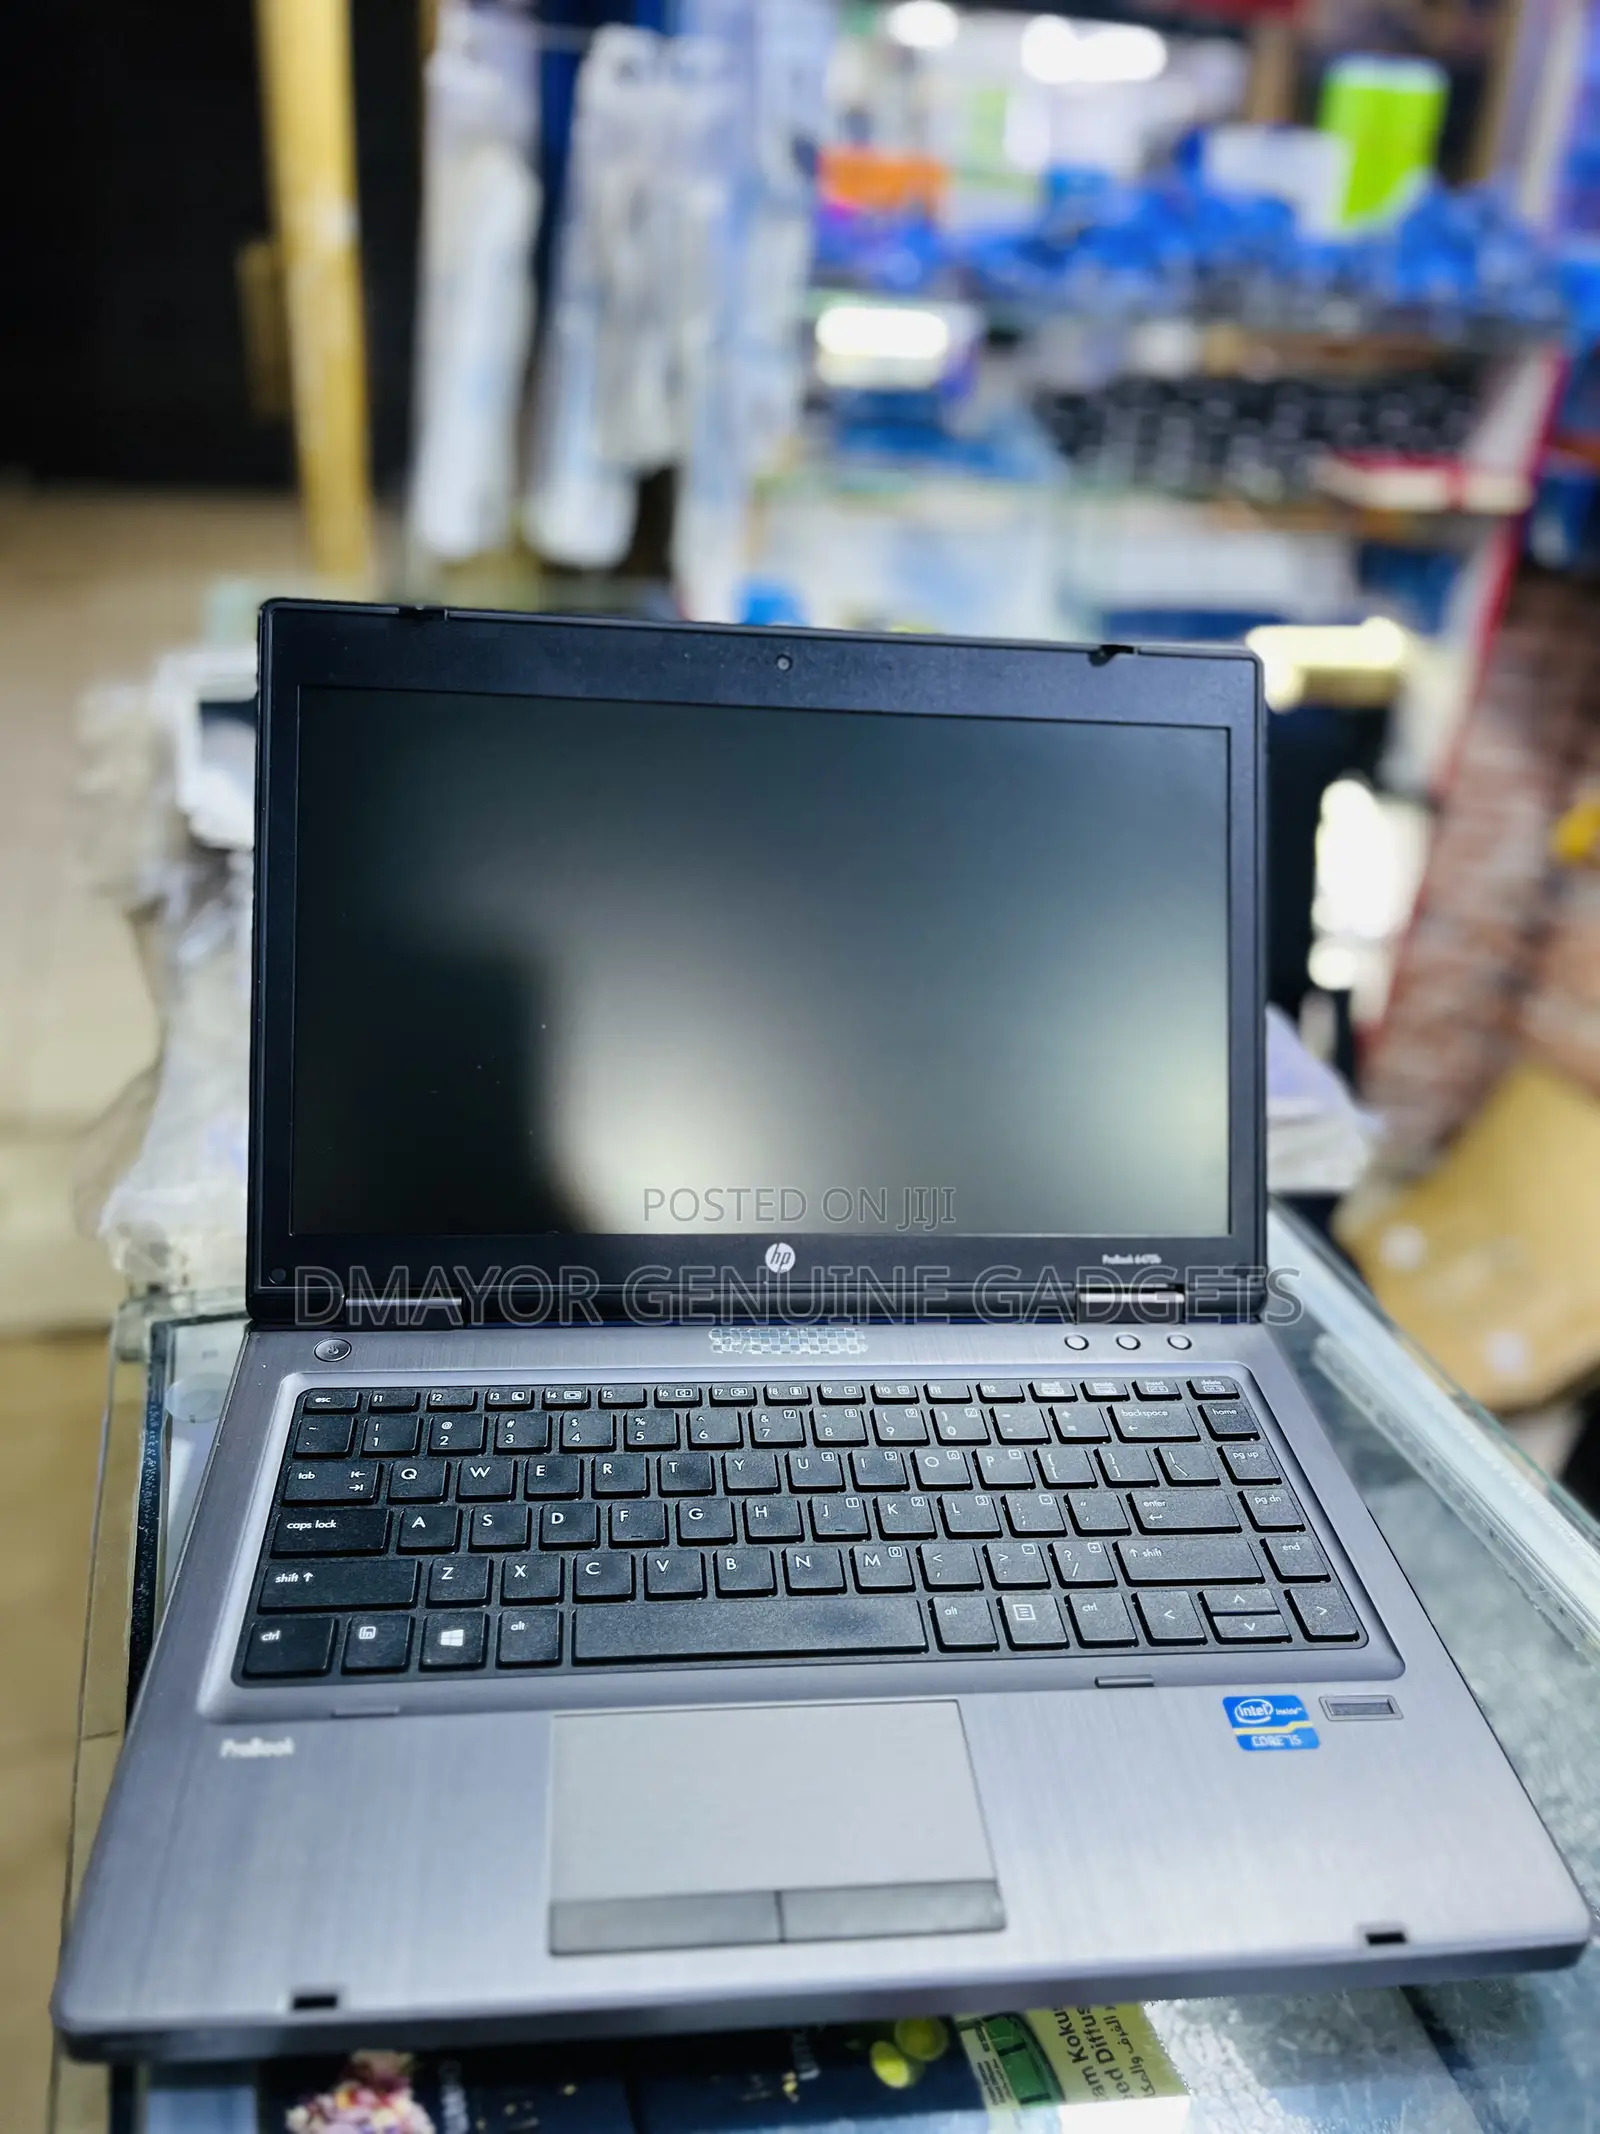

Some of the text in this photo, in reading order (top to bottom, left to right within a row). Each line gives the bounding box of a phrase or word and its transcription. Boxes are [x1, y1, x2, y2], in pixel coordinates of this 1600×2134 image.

[767, 1243, 794, 1273] hp
[490, 1391, 500, 1401] f3
[546, 1391, 557, 1400] f4
[601, 1389, 614, 1399] f5
[658, 1388, 669, 1398] f6
[714, 1388, 724, 1397] f7
[768, 1386, 779, 1396] f8
[823, 1386, 833, 1395] f9
[315, 1396, 332, 1404] esc
[373, 1393, 384, 1403] f1
[431, 1393, 443, 1402] f2
[1121, 1408, 1168, 1420] backspace
[1212, 1407, 1238, 1416] home
[636, 1430, 645, 1442] 5
[699, 1429, 709, 1439] 6
[761, 1428, 771, 1438] 7
[825, 1427, 834, 1437] 8
[886, 1426, 895, 1436] 9
[946, 1426, 957, 1436] 0
[373, 1436, 379, 1447] 1
[439, 1435, 449, 1446] 2
[504, 1433, 515, 1444] 3
[571, 1432, 581, 1443] 4
[1232, 1450, 1259, 1461] pg up
[734, 1460, 745, 1471] Y
[798, 1458, 809, 1470] U
[925, 1456, 939, 1468] O
[986, 1456, 995, 1467] P
[470, 1465, 490, 1479] W
[535, 1465, 546, 1477] E
[602, 1463, 613, 1474] R
[668, 1461, 678, 1474] T
[298, 1470, 316, 1480] tab
[401, 1467, 418, 1481] Q
[1143, 1499, 1166, 1508] enter
[1254, 1495, 1267, 1506] pg
[755, 1506, 768, 1518] H
[821, 1505, 830, 1517] J
[887, 1503, 899, 1515] K
[952, 1502, 960, 1514] L
[551, 1512, 564, 1525] D
[619, 1510, 629, 1522] F
[688, 1508, 704, 1520] G
[286, 1519, 337, 1531] caps lock
[411, 1516, 426, 1529] A
[482, 1514, 493, 1527] S
[1282, 1542, 1301, 1552] end
[1142, 1548, 1162, 1558] shift
[656, 1560, 670, 1572] V
[726, 1558, 737, 1570] B
[795, 1556, 811, 1569] N
[865, 1554, 880, 1567] M
[441, 1567, 454, 1580] Z
[513, 1565, 527, 1578] X
[585, 1562, 600, 1575] C
[275, 1573, 299, 1584] shift
[944, 1606, 958, 1616] alt
[1082, 1602, 1097, 1613] ctrl
[510, 1621, 525, 1631] alt
[261, 1630, 281, 1642] ctrl
[1251, 1735, 1285, 1747] CORE
[1082, 2065, 1109, 2100] am
